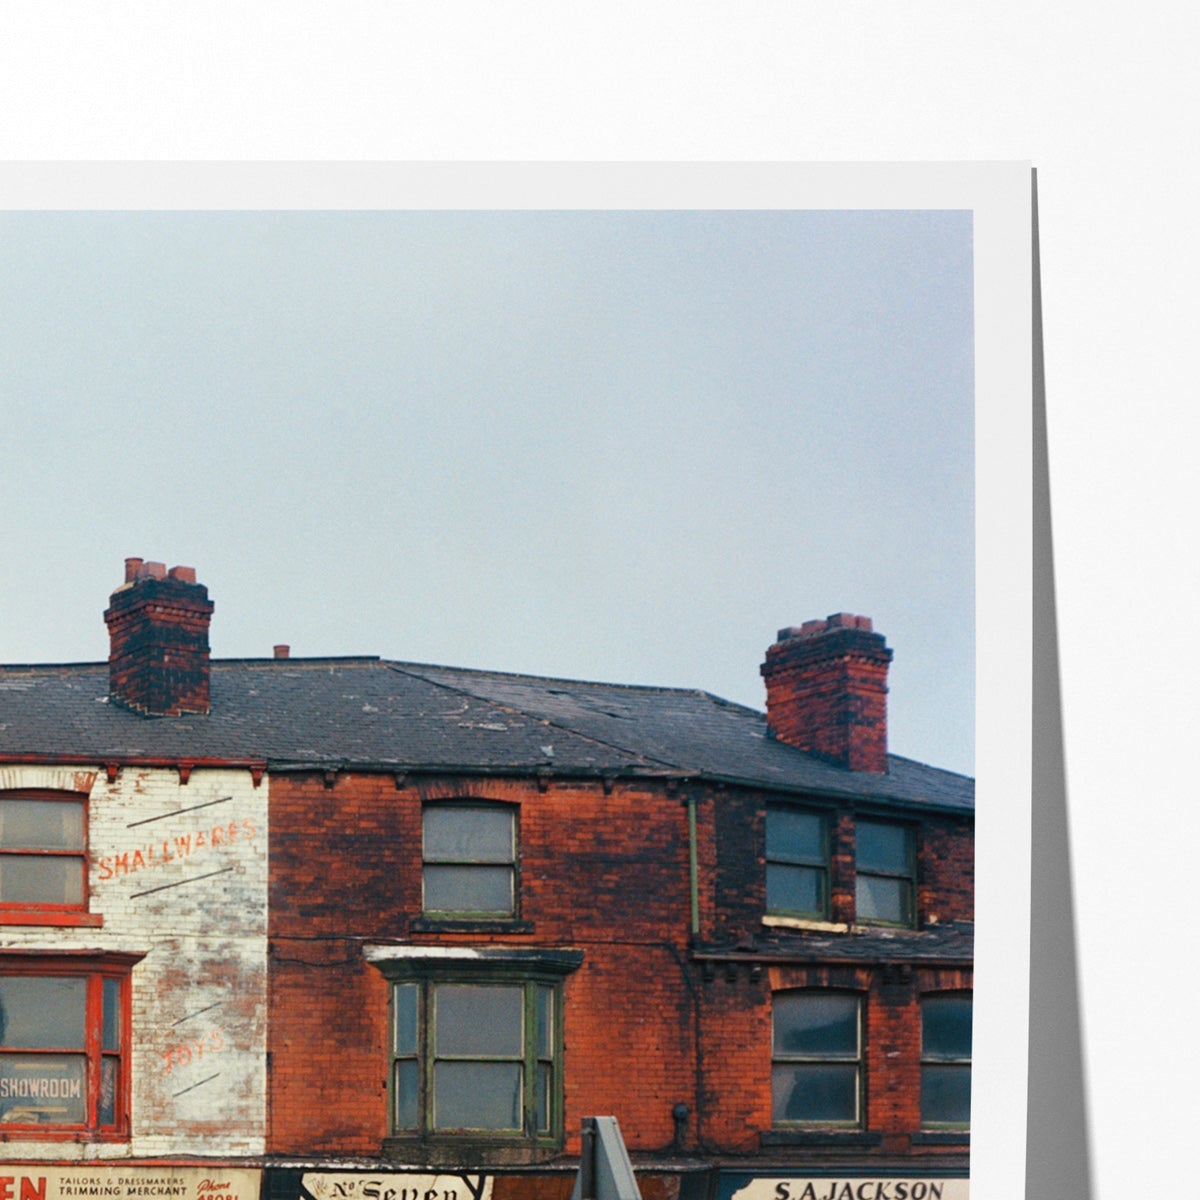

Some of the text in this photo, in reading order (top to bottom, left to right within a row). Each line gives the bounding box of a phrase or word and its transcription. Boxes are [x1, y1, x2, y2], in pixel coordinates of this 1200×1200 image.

[98, 818, 258, 881] SMALLWARES
[163, 1027, 225, 1076] TOYS
[0, 1077, 81, 1099] SHOWROOM
[59, 1177, 101, 1185] TAILORS
[118, 1177, 185, 1185] DRESSMAKERS
[197, 1179, 231, 1196] Phone
[59, 1186, 188, 1196] TRIMMING MERCHANT
